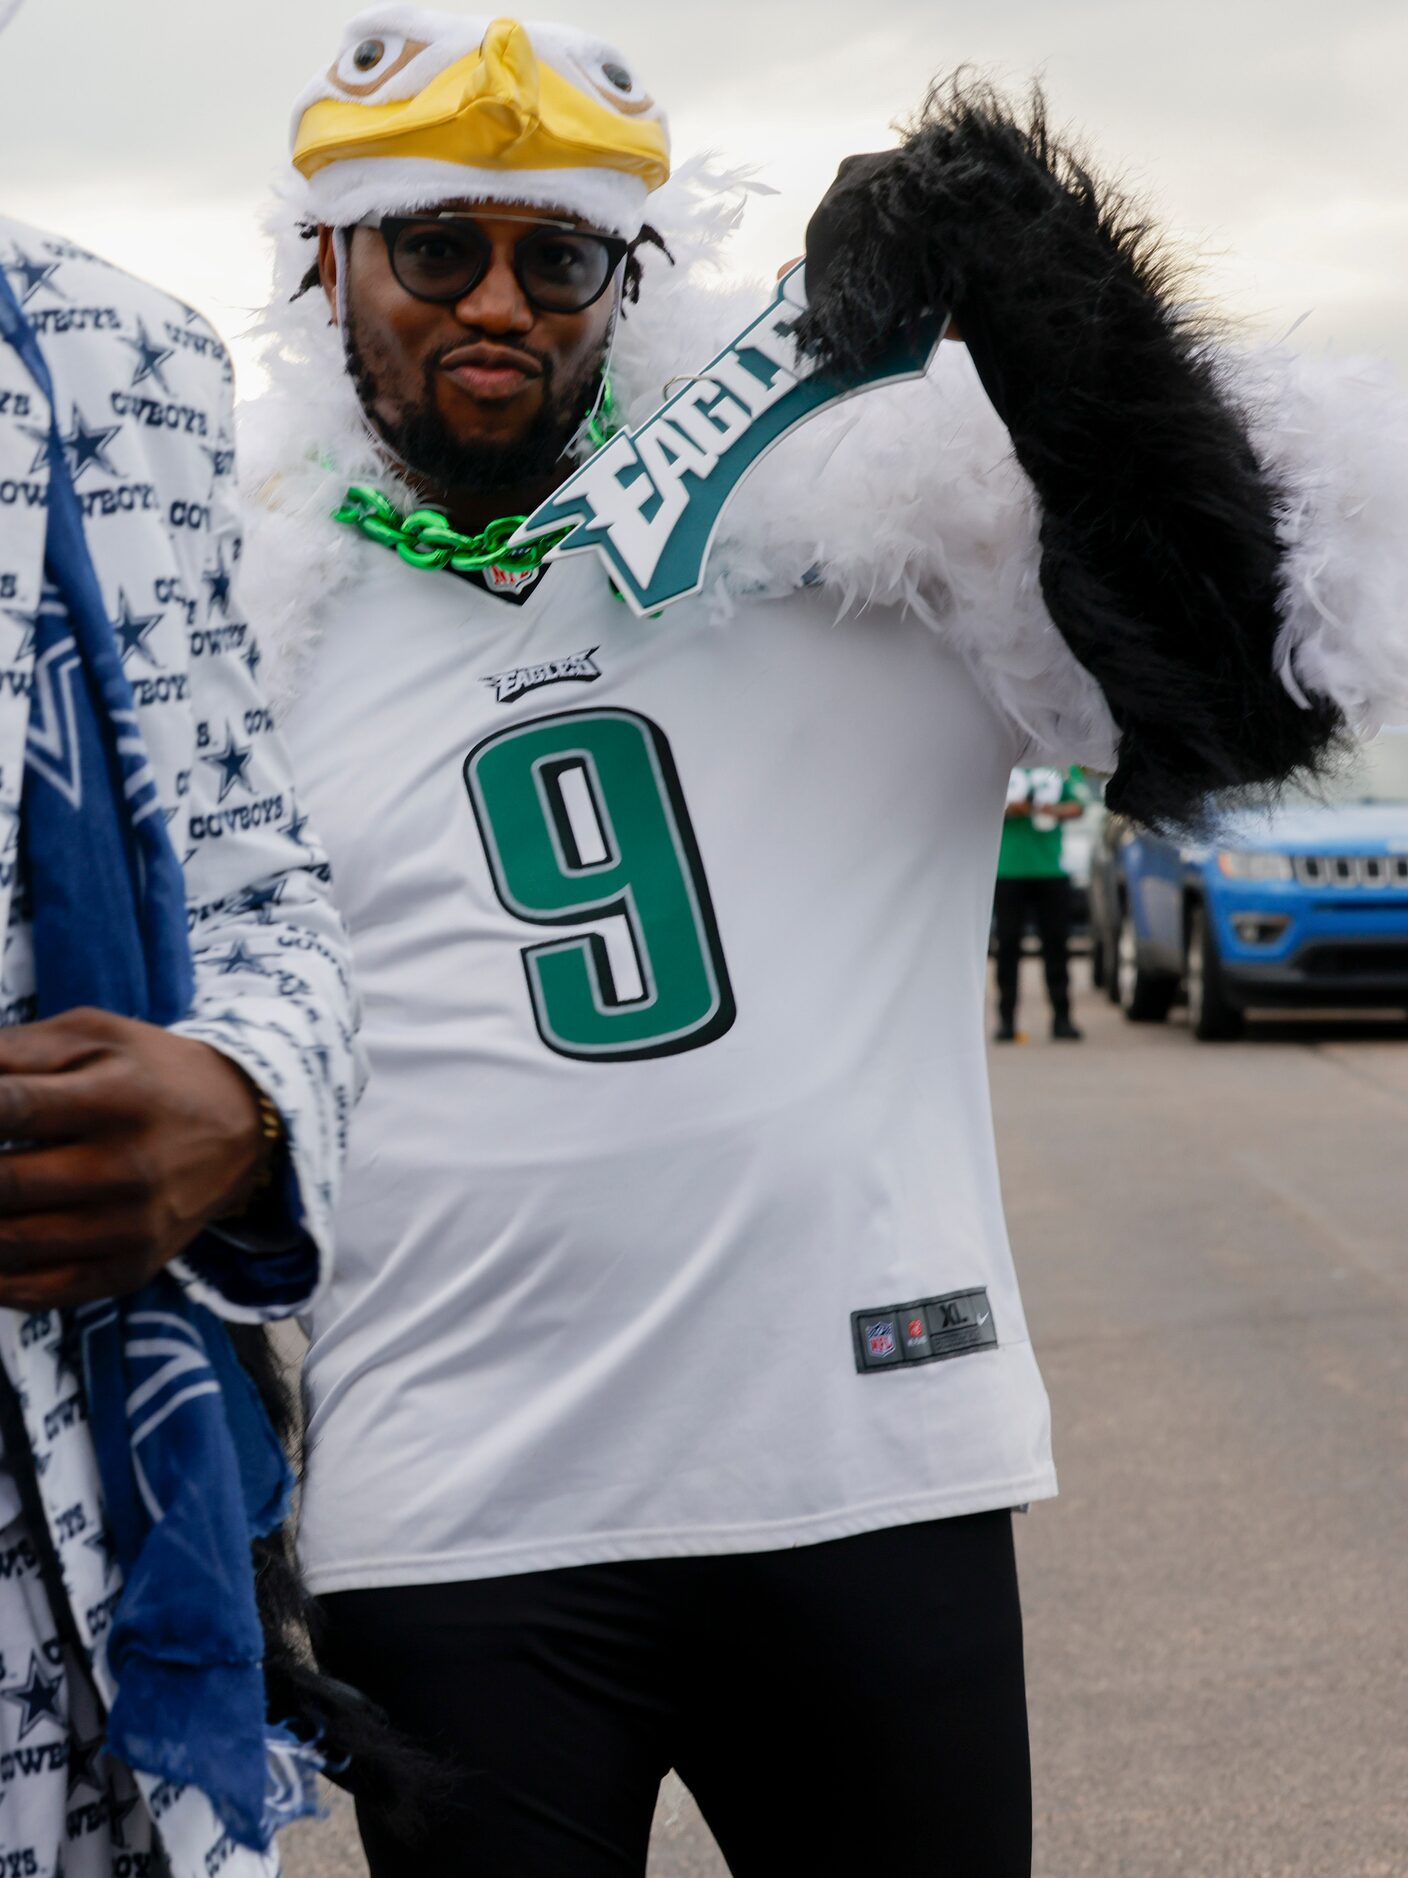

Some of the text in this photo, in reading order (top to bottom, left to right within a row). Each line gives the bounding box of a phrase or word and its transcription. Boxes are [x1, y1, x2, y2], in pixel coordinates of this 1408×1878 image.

[479, 645, 602, 703] EAGLES
[463, 706, 737, 1063] 9
[939, 1302, 968, 1328] XL
